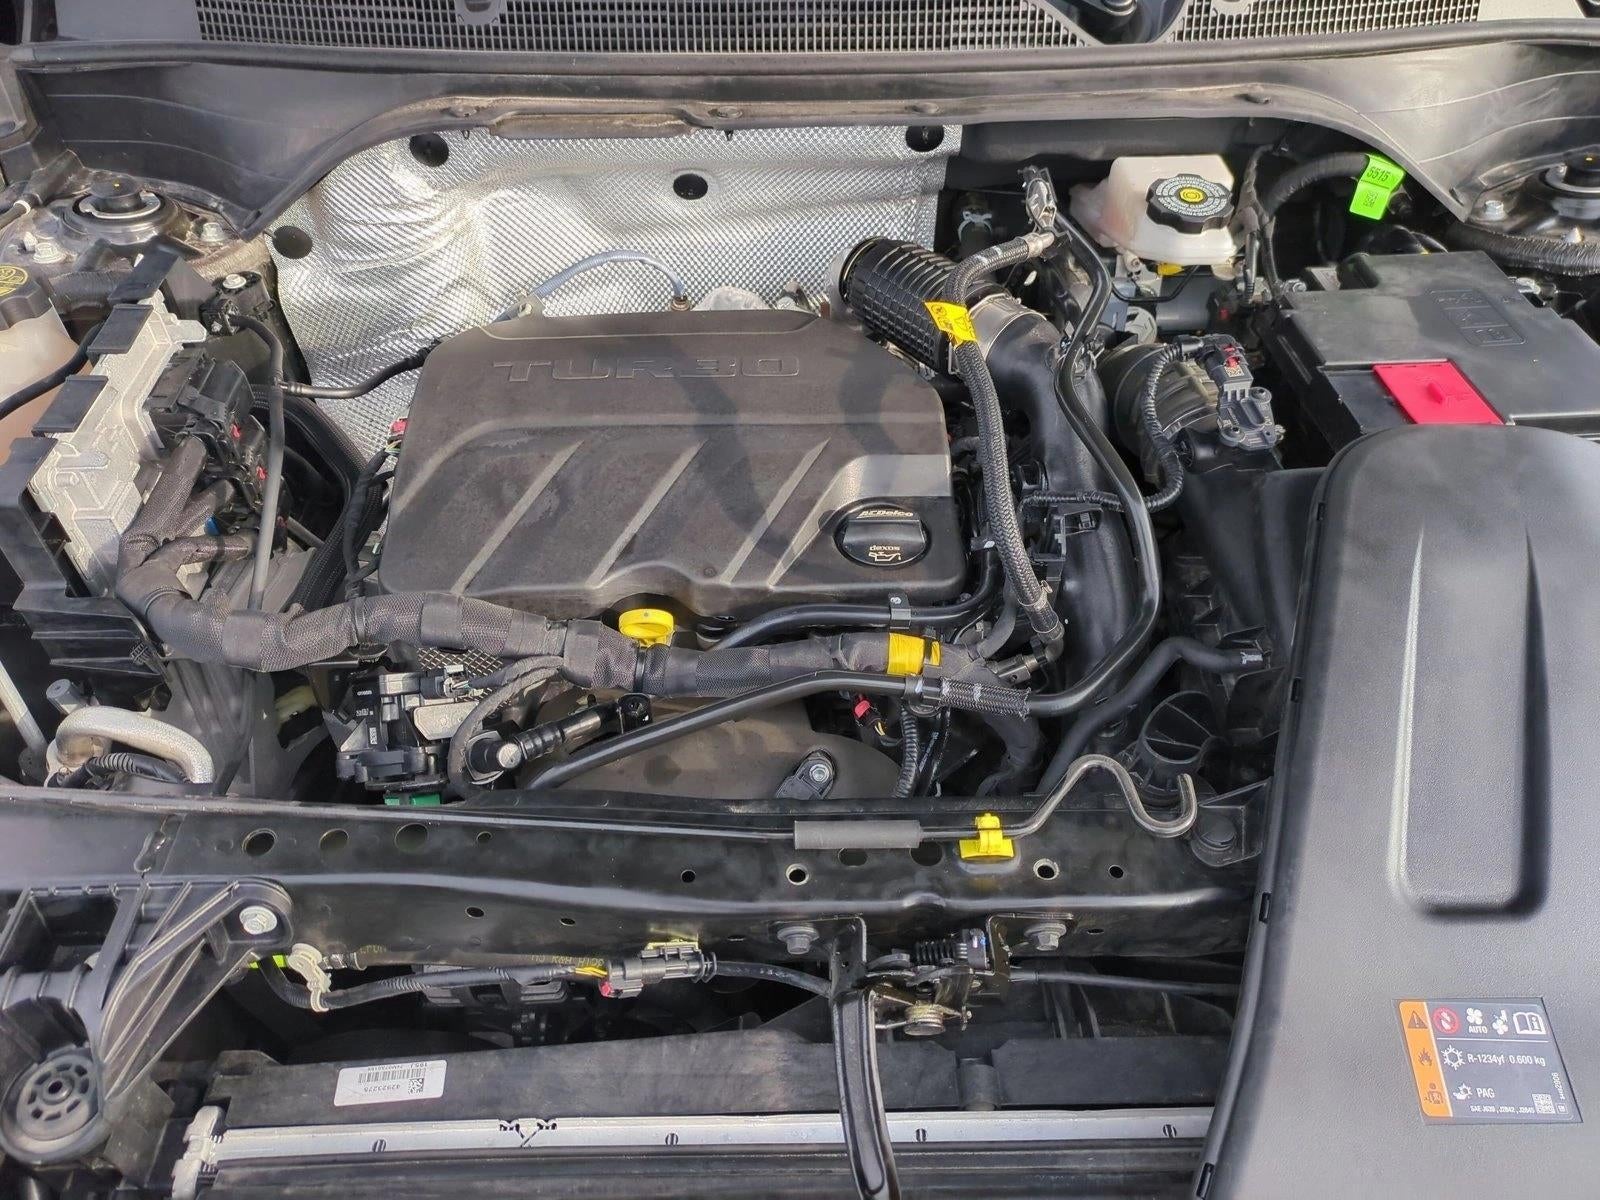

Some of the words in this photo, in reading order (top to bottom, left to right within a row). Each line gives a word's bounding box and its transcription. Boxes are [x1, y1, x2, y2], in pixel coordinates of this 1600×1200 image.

[493, 356, 800, 383] TURBO
[856, 509, 915, 519] ACDelco
[1468, 1025, 1488, 1034] AUTO
[1467, 1053, 1505, 1066] R-1234yf
[1509, 1054, 1533, 1065] 0.600
[1534, 1055, 1546, 1067] kg
[1476, 1087, 1495, 1099] PAG
